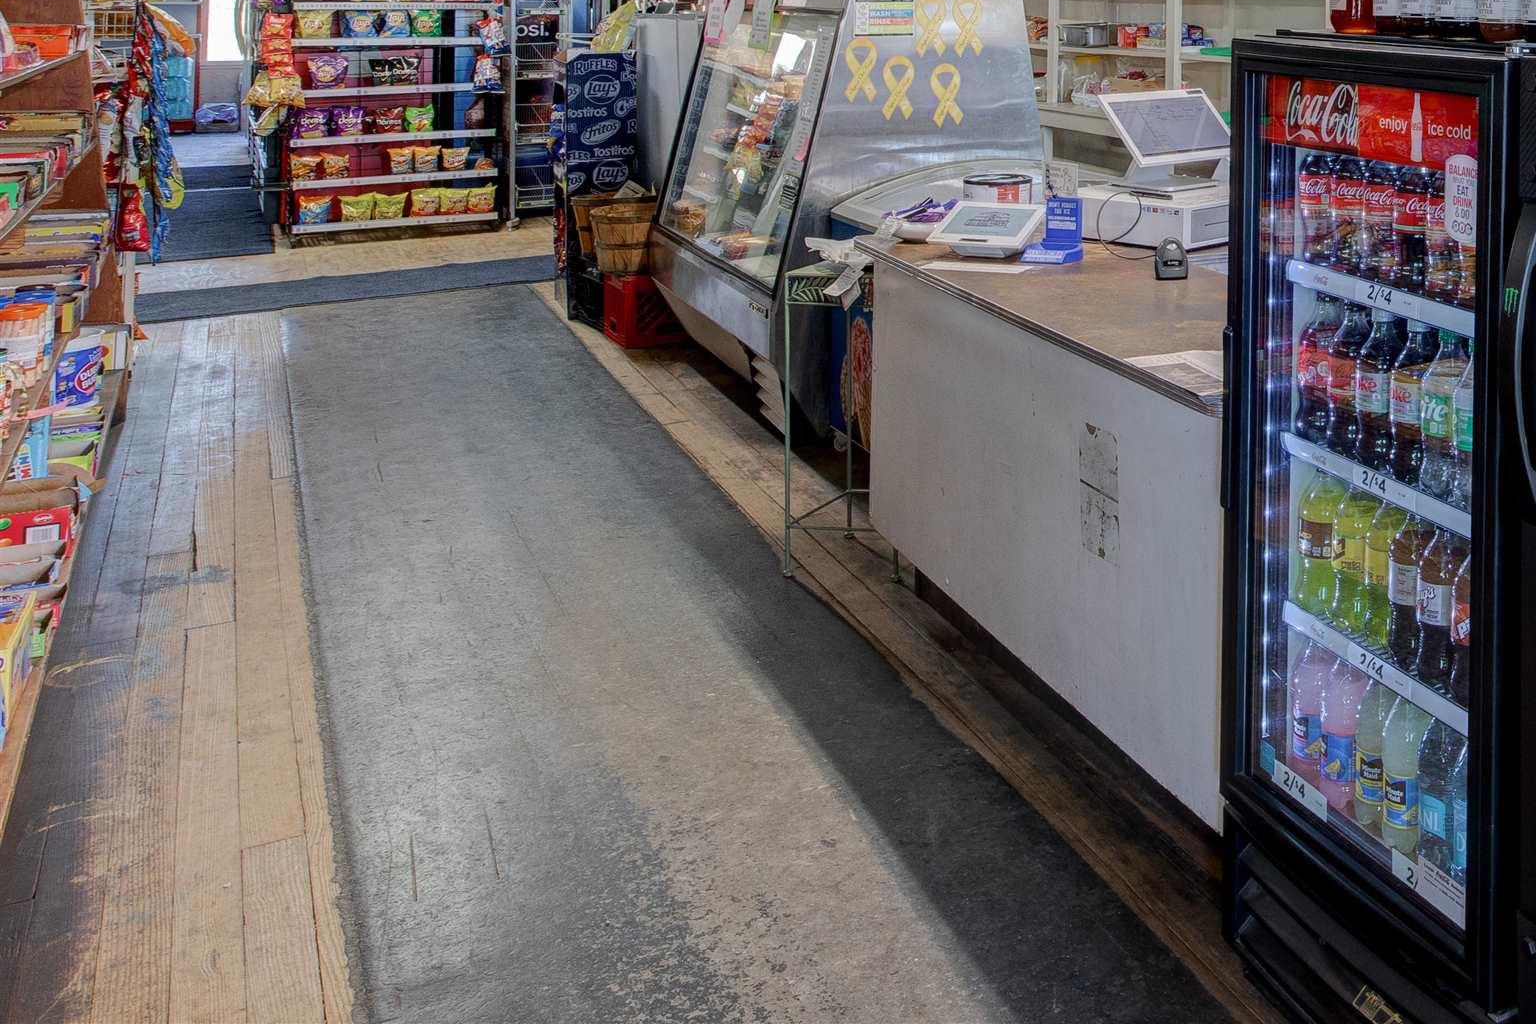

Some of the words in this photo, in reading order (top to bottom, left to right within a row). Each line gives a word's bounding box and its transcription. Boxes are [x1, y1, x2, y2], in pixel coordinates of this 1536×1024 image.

[574, 58, 618, 75] RUFFLES
[1379, 117, 1408, 134] enjoy
[1428, 121, 1444, 136] ice
[1446, 123, 1471, 140] cold
[593, 145, 635, 157] Tostitos
[1456, 185, 1470, 195] EAT
[1452, 195, 1473, 208] DRINK
[1367, 284, 1392, 305] 2/$4
[1361, 470, 1386, 494] 2/$4
